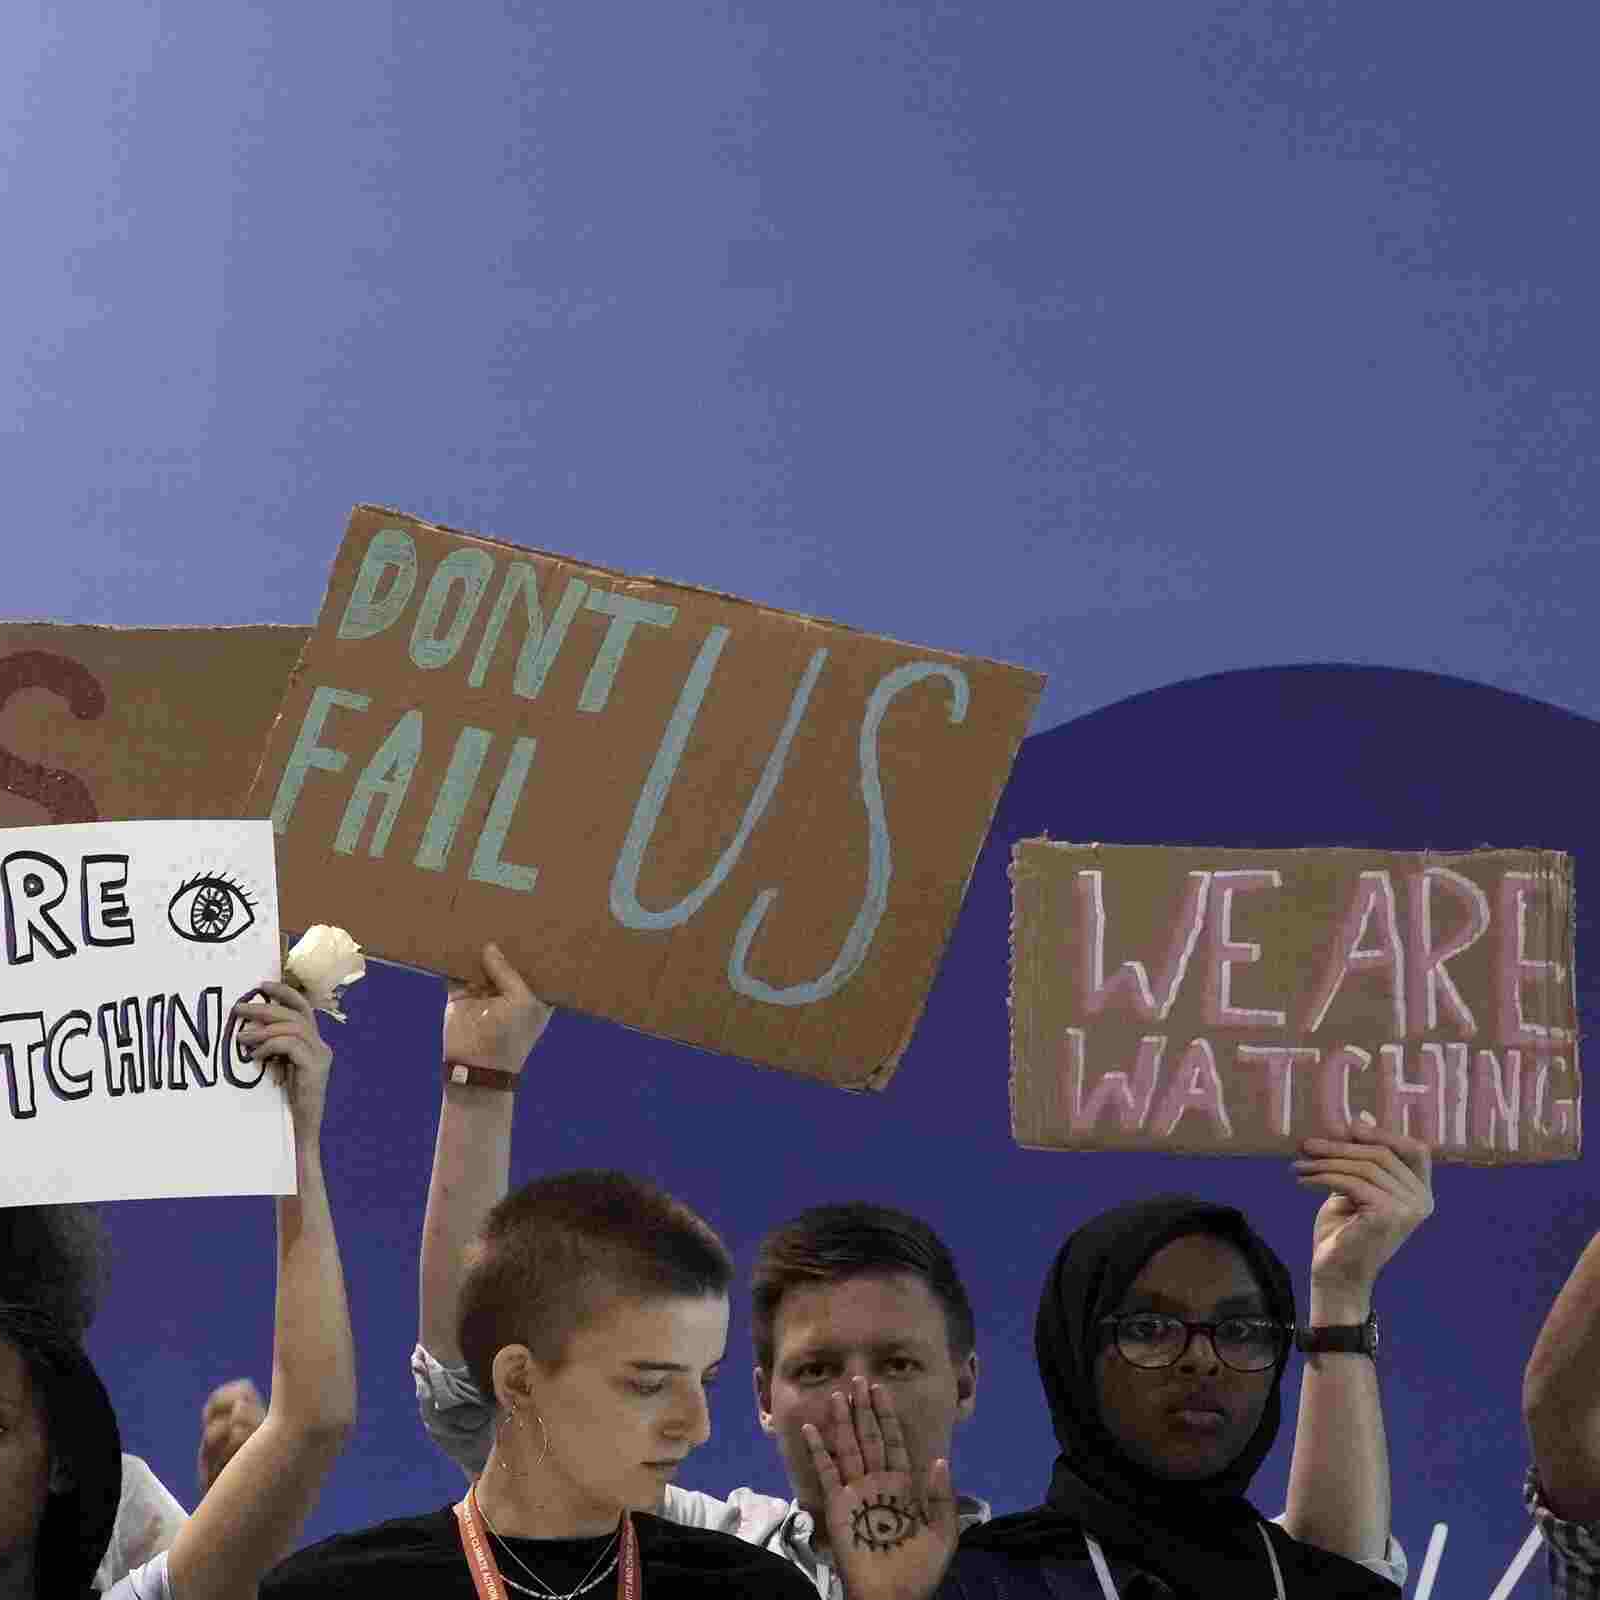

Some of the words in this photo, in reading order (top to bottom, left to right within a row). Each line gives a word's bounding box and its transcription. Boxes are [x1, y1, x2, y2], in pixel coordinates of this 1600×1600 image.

[337, 528, 679, 713] DONT
[272, 687, 538, 893] FAIL
[609, 624, 971, 1006] US
[1074, 869, 1285, 1030] WE
[1302, 865, 1577, 1050] ARE
[1064, 1027, 1573, 1152] WATCHING
